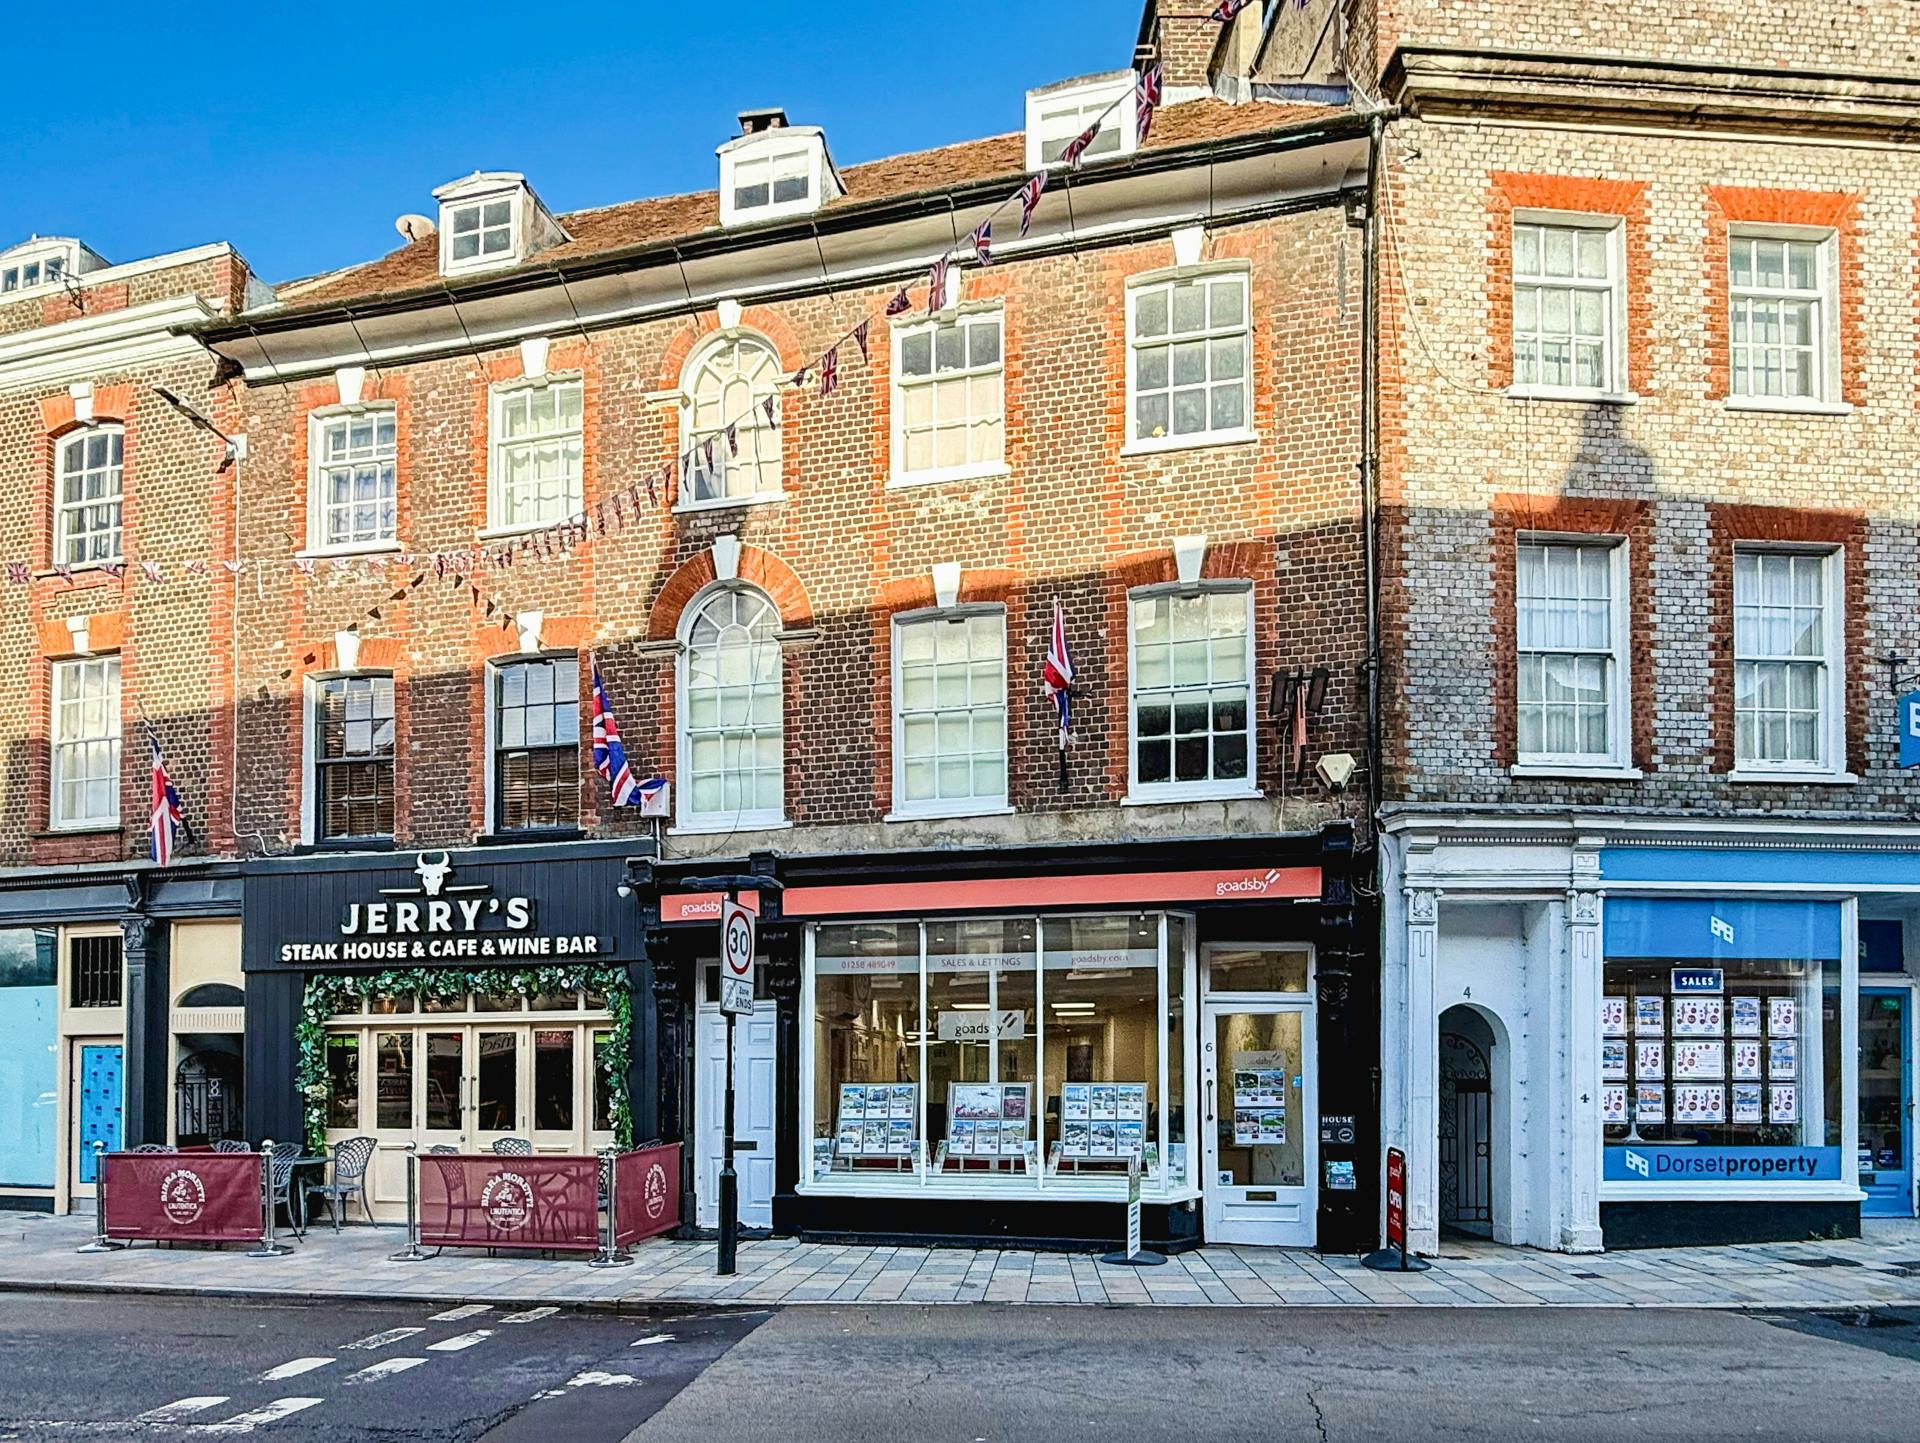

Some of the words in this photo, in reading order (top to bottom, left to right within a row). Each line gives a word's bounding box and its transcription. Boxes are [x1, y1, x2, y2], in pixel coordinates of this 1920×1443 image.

[1216, 876, 1269, 896] goadsby
[341, 897, 529, 934] JERRY'S
[281, 943, 338, 962] STEAK
[343, 941, 408, 960] HOUSE
[411, 940, 425, 958] &
[433, 938, 477, 957] CAFE
[481, 938, 495, 955] &
[498, 936, 550, 955] WINE
[556, 935, 597, 954] BAR
[729, 927, 749, 957] 30
[941, 958, 966, 968] SALES
[968, 957, 975, 967] &
[978, 956, 1021, 967] LETTINGS
[1681, 976, 1714, 986] SALES
[1463, 986, 1471, 999] 4
[736, 997, 752, 1010] ENDS
[954, 1022, 1003, 1036] goadsy
[1205, 1042, 1213, 1052] 6
[210, 1079, 219, 1097] 8
[1580, 1093, 1590, 1104] 4
[1321, 1116, 1353, 1124] HOUSE
[1656, 1153, 1818, 1176] Dorsetproperty
